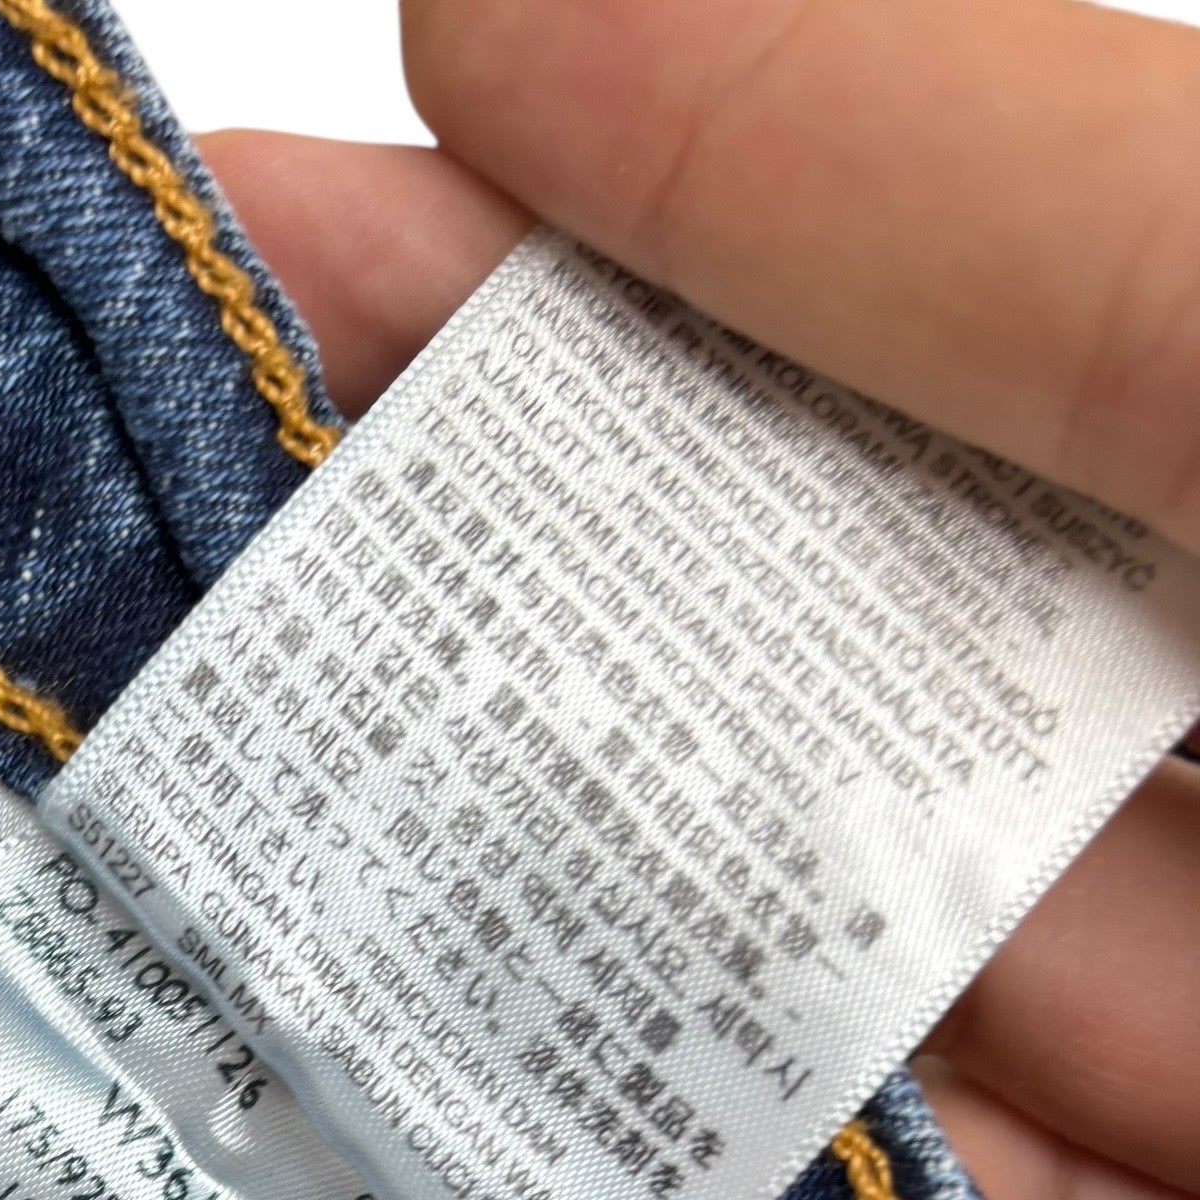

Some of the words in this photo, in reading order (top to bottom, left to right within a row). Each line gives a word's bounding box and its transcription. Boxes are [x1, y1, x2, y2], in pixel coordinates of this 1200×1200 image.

[616, 490, 711, 585] PERTE
[705, 579, 735, 608] A
[738, 669, 836, 768] PERTE
[829, 759, 860, 791] V
[64, 803, 157, 900] S51227
[173, 924, 238, 991] SML
[224, 981, 276, 1035] MX
[117, 734, 301, 938] PENGERINGAN
[389, 1040, 506, 1165] DENGAN
[196, 888, 327, 1029] GUNAKAN
[316, 1024, 412, 1128] SABUN
[402, 1120, 479, 1200] CUCI
